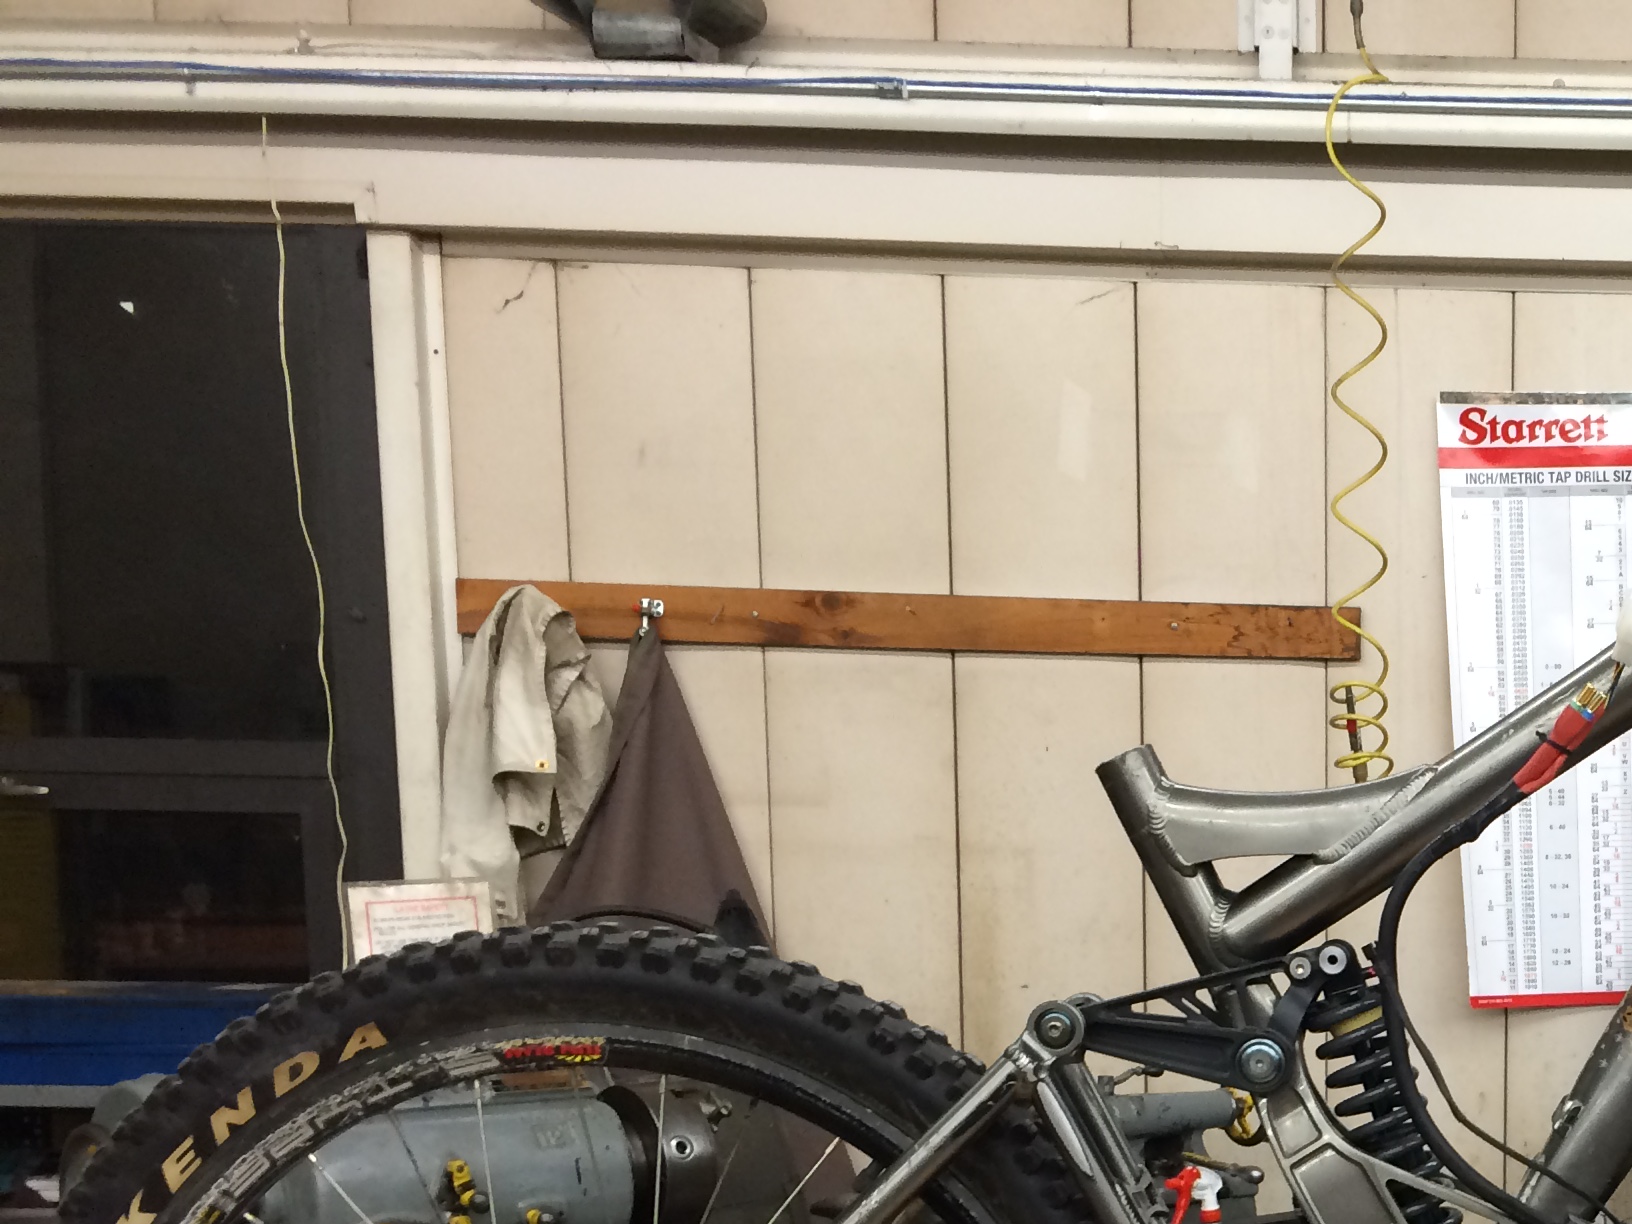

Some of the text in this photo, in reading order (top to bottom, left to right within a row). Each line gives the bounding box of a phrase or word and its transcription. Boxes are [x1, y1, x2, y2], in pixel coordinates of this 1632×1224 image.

[1458, 407, 1609, 445] Starrett
[1465, 472, 1545, 485] INCH/METRIC
[1548, 471, 1572, 484] TAP
[1575, 470, 1610, 483] DRILL
